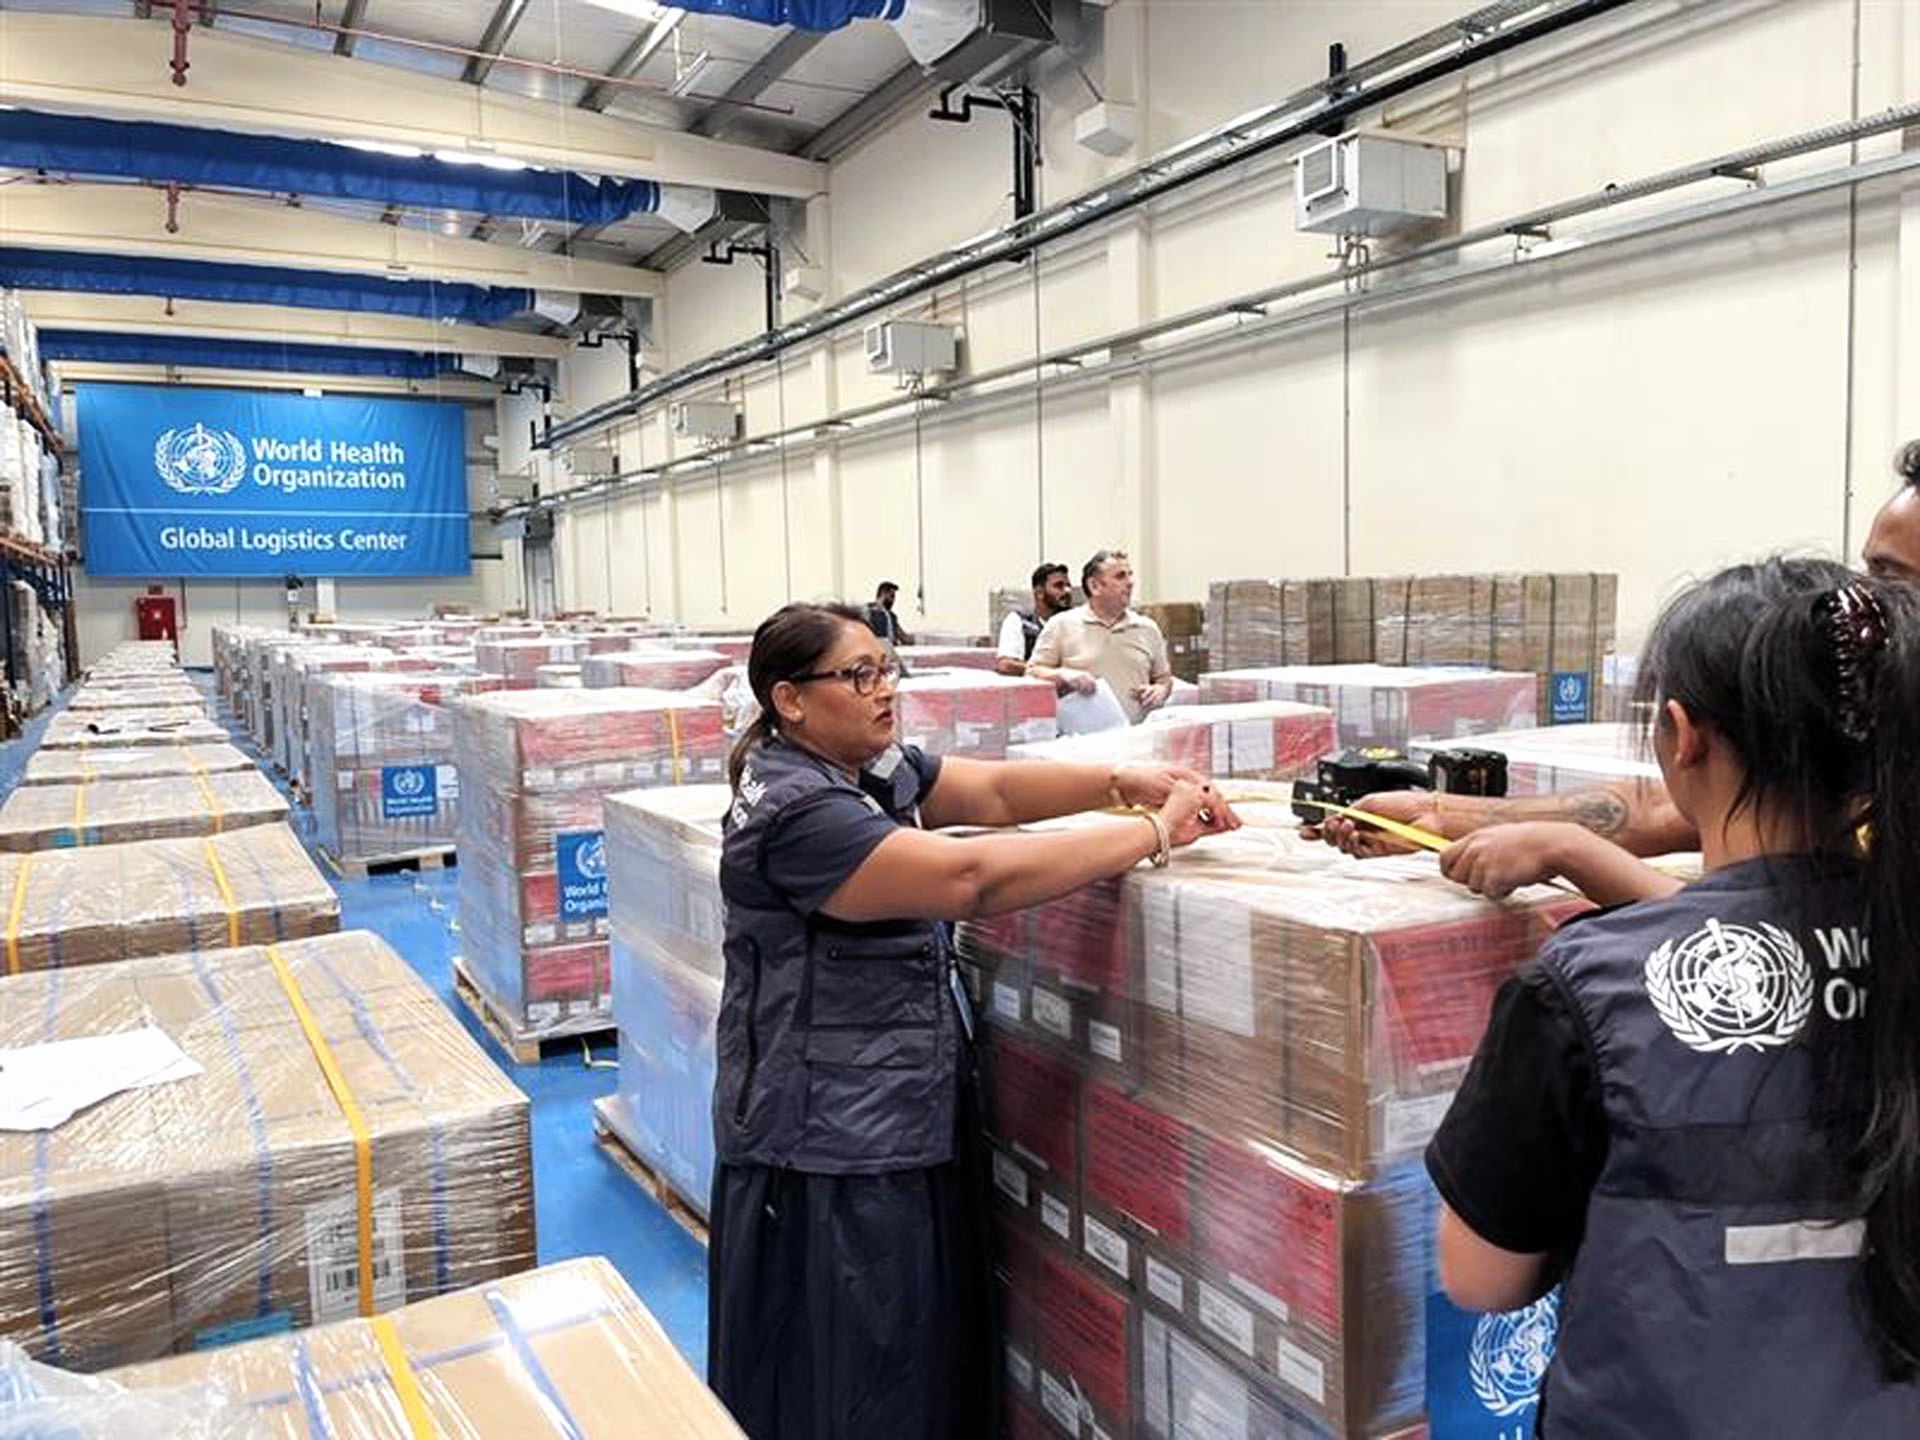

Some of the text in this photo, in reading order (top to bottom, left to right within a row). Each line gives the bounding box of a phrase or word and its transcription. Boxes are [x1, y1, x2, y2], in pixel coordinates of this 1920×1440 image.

[252, 437, 405, 465] World Health
[253, 463, 405, 492] Organization
[160, 527, 408, 555] Global Logistics Center
[563, 882, 600, 898] World
